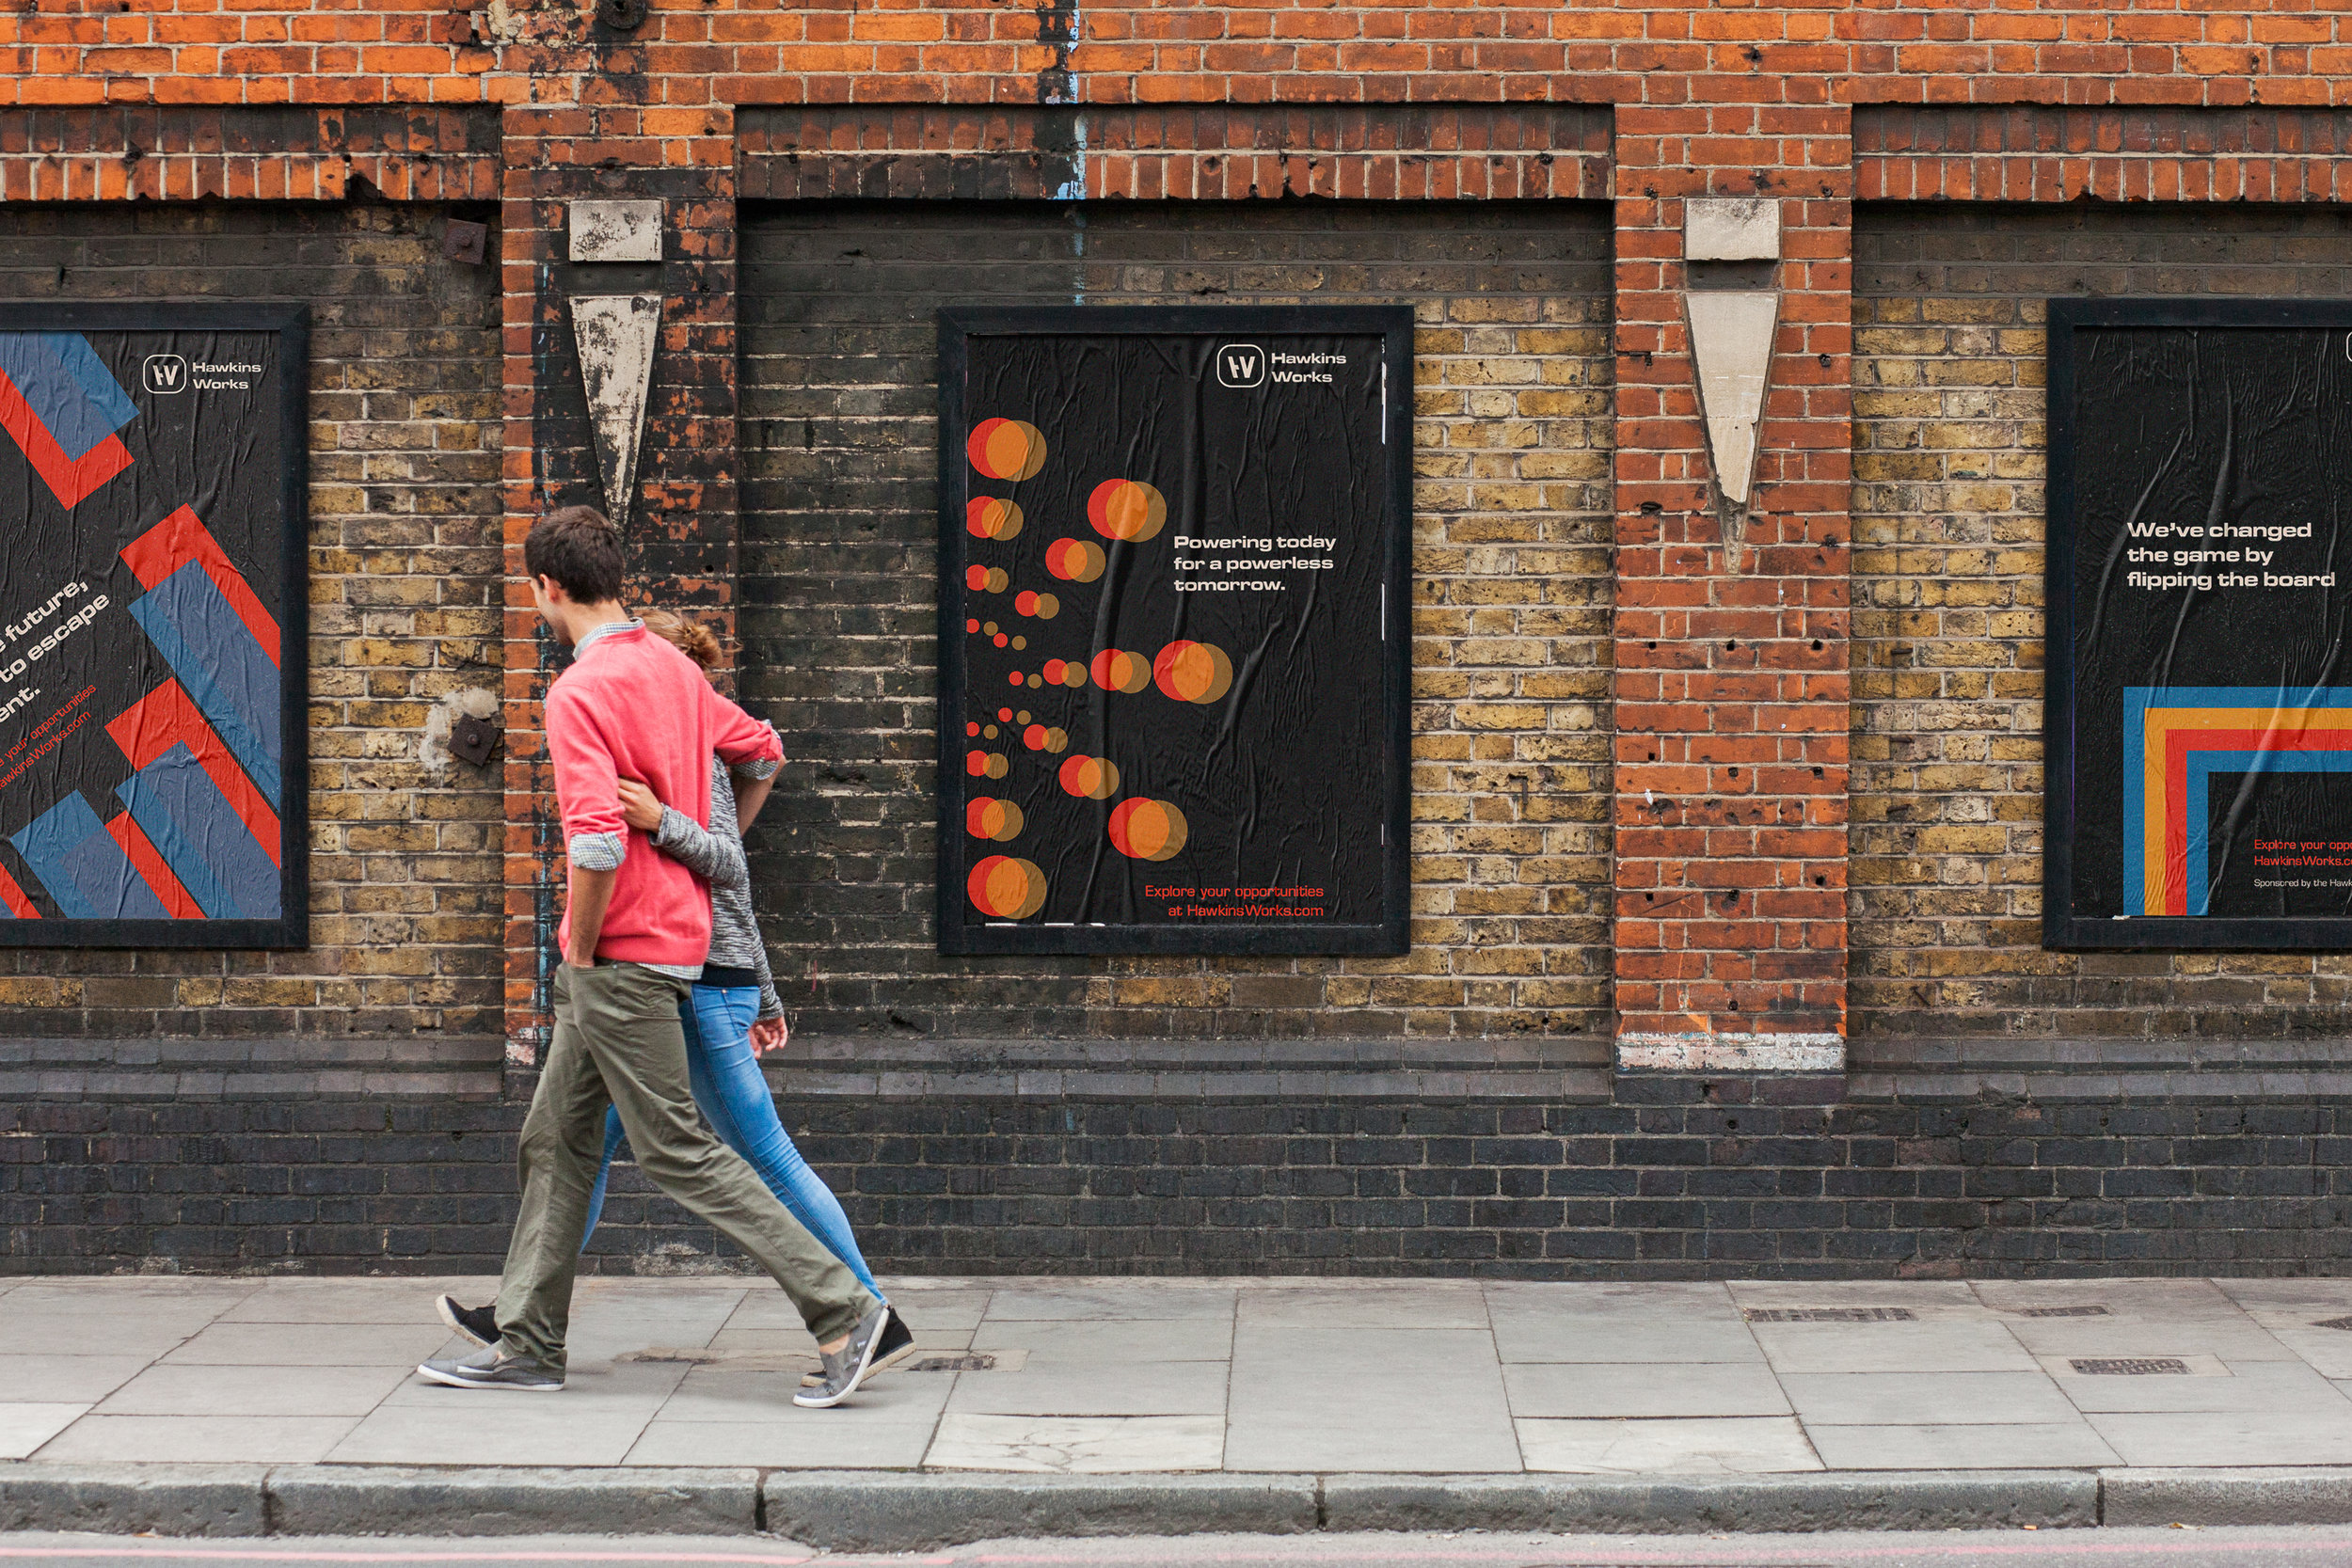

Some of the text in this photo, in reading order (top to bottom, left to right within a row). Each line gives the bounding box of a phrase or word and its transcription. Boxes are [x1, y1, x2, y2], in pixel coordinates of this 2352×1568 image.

[192, 361, 262, 373] Hawkins
[1271, 353, 1347, 365] Hawkins
[192, 378, 249, 390] Works
[1271, 371, 1333, 384] Works
[2127, 522, 2312, 542] We've changed
[1173, 535, 1337, 552] Powering today
[2127, 546, 2274, 566] the game by
[1173, 556, 1334, 574] for a powerless
[1173, 579, 1286, 592] tomorrow.
[2127, 571, 2336, 591] flipping the board
[5, 580, 89, 642] future,
[27, 594, 110, 661] escape
[5, 684, 97, 762] your opportunities
[0, 710, 92, 790] awkinsWorks.com
[2254, 839, 2296, 852] Explore
[2300, 841, 2326, 852] your
[2254, 855, 2352, 866] HawkinsWorks.c
[2253, 879, 2299, 888] Sponsored
[2301, 879, 2312, 888] by
[2313, 879, 2328, 887] the
[1145, 884, 1325, 900] Explore your opportunities
[1168, 904, 1324, 917] at HawkinsWorks.com
